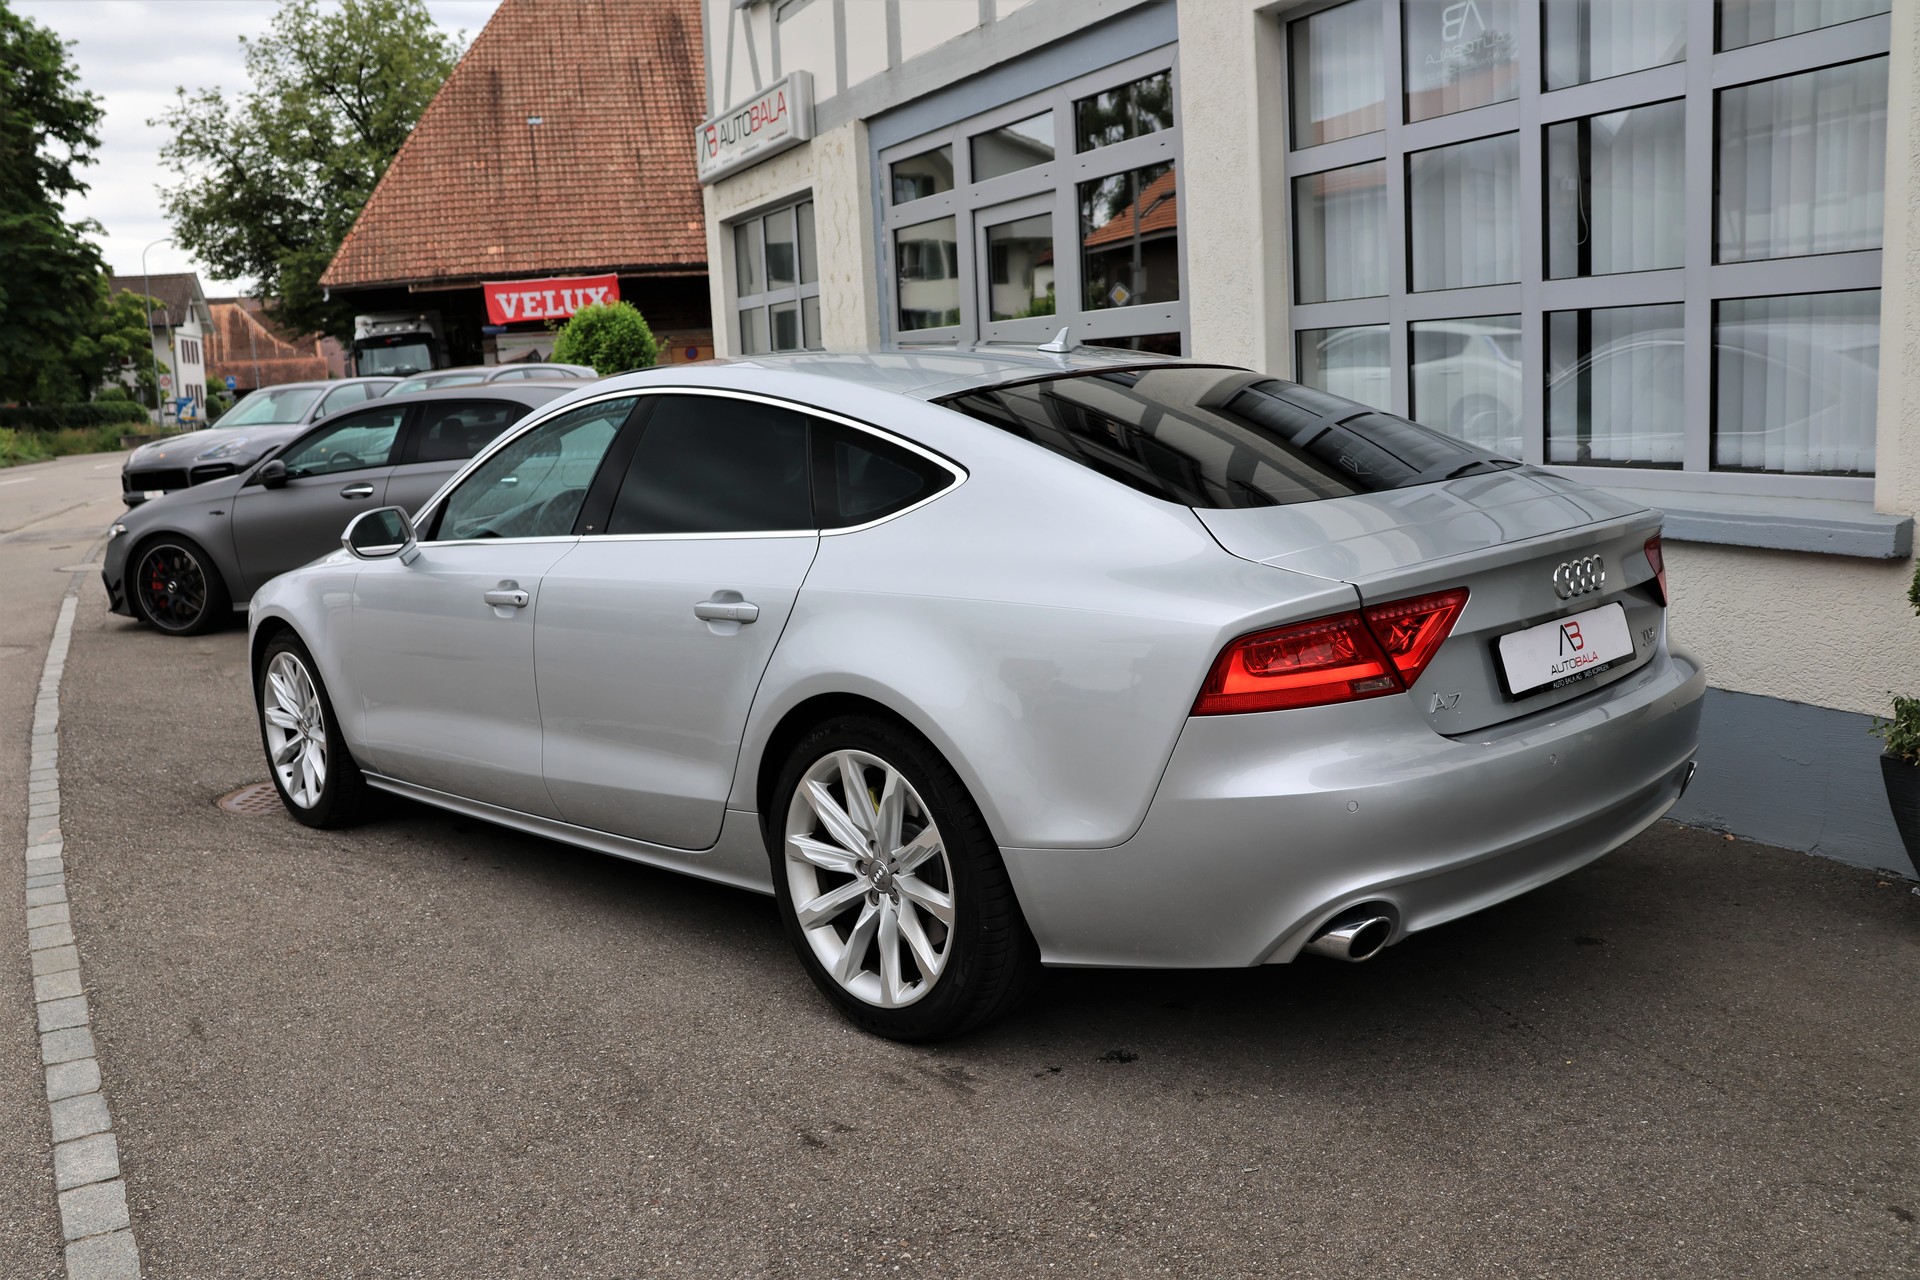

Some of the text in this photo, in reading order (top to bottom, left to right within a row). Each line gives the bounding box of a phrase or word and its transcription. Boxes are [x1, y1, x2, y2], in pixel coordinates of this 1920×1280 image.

[719, 90, 788, 149] AUTOBALA
[495, 286, 608, 319] VELUX
[1559, 620, 1584, 656] AB
[1551, 651, 1599, 676] AUTOBALA
[1429, 691, 1462, 714] A7
